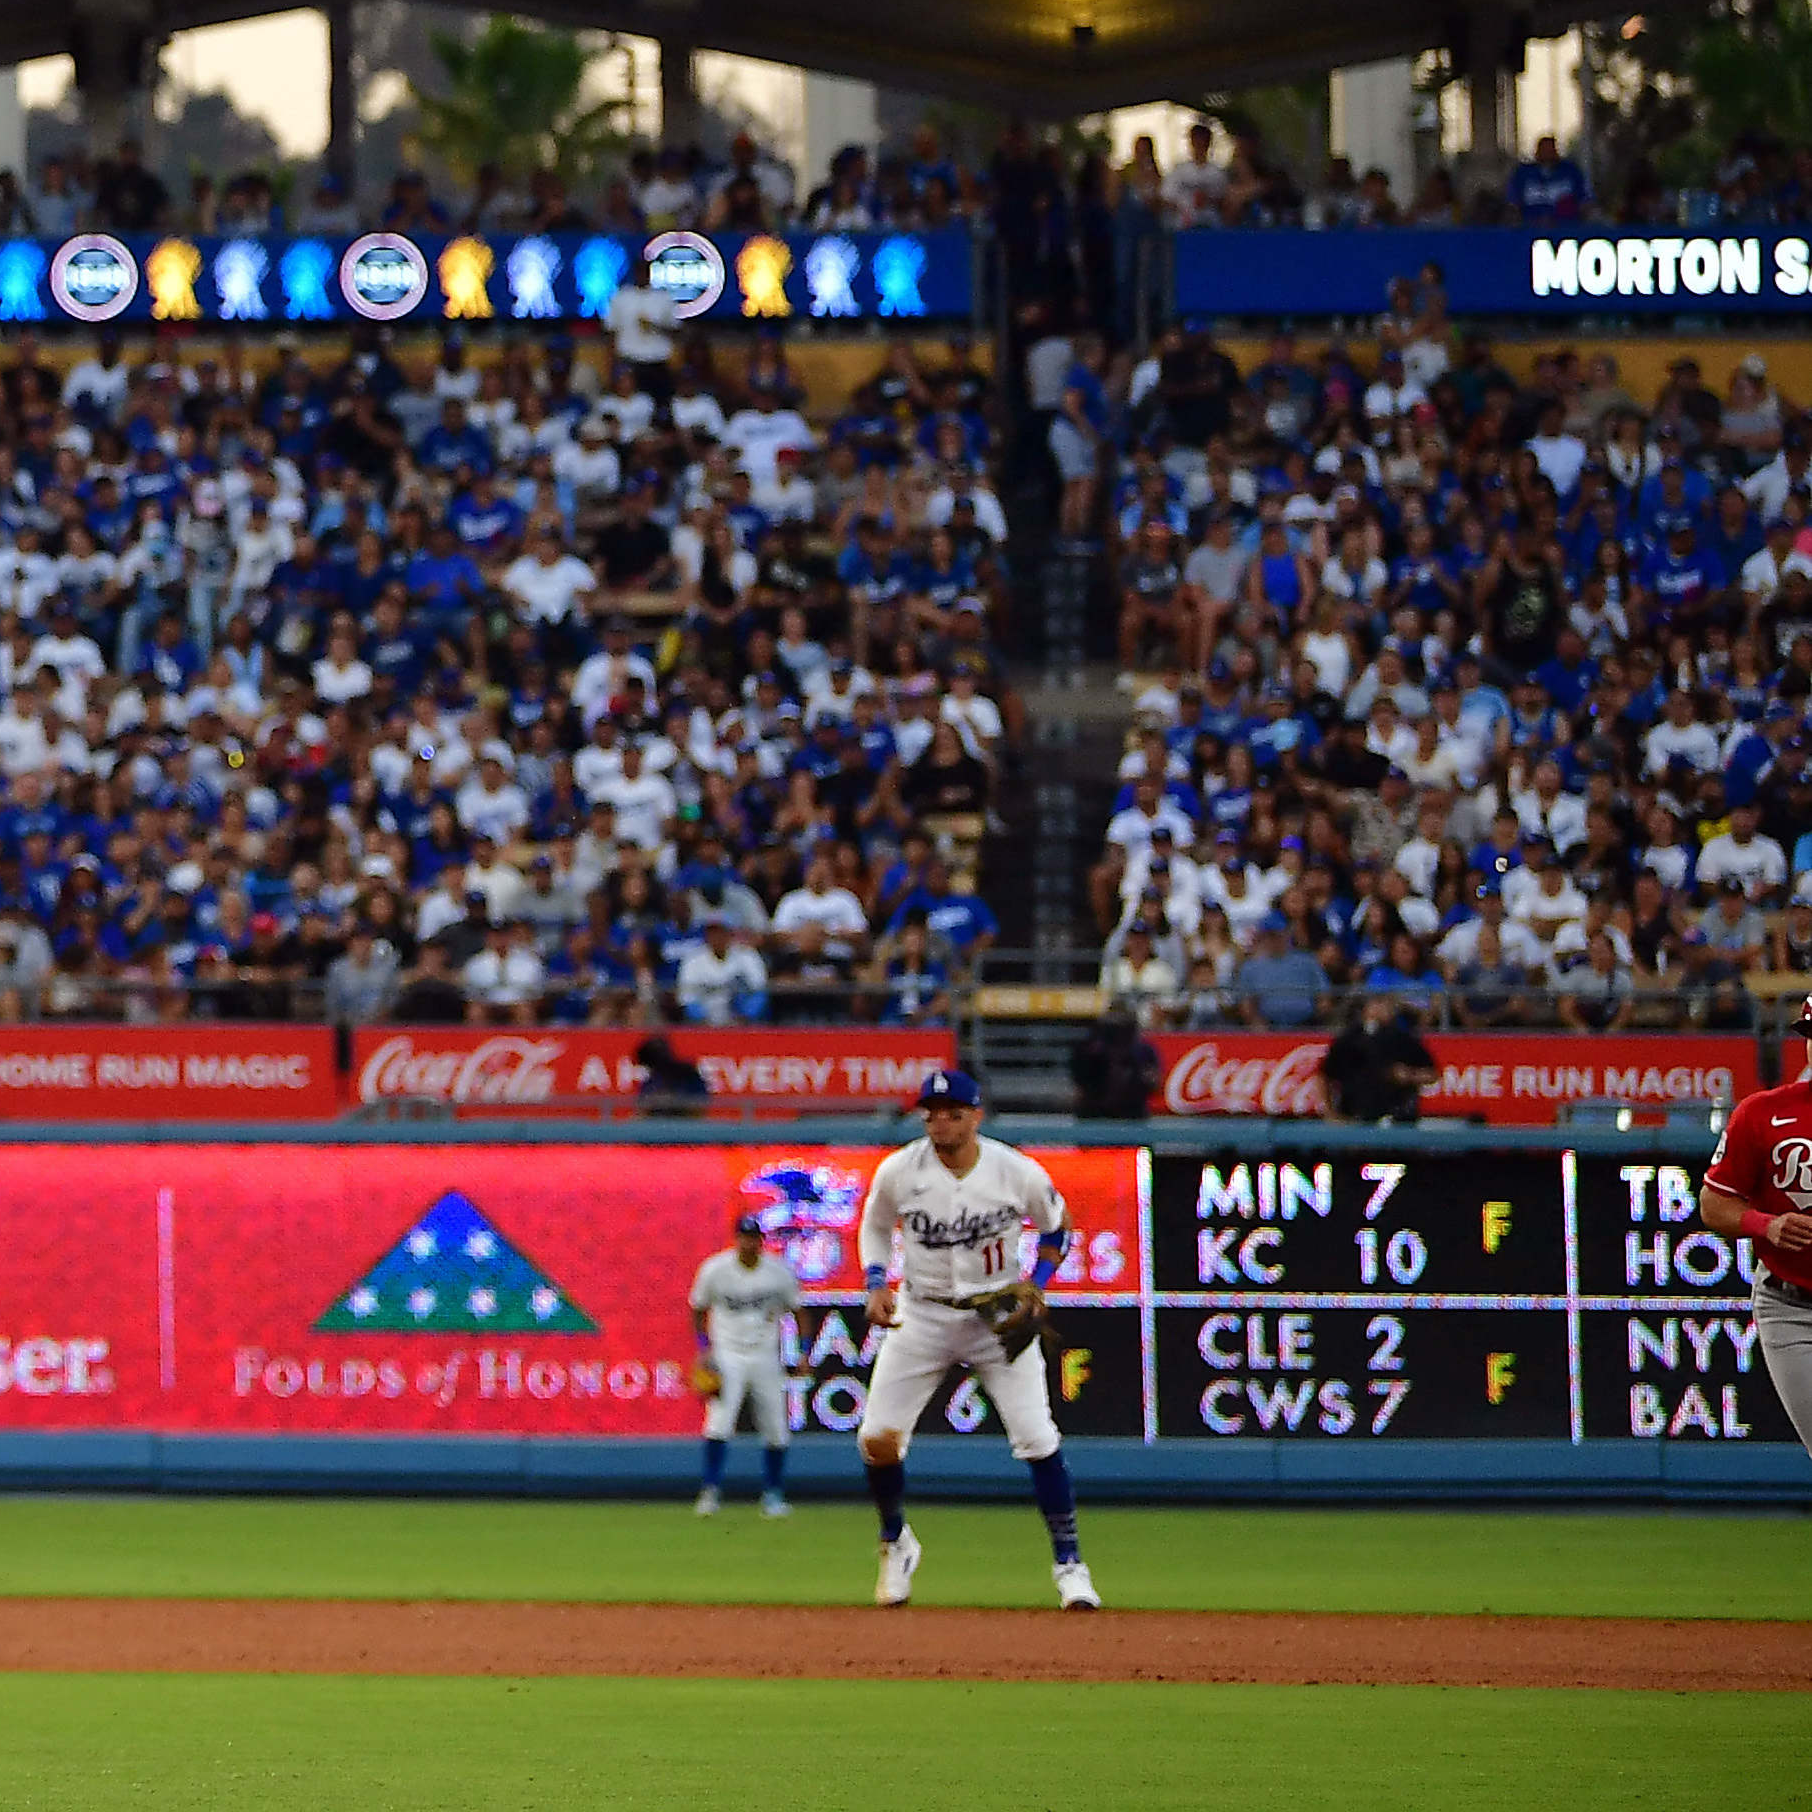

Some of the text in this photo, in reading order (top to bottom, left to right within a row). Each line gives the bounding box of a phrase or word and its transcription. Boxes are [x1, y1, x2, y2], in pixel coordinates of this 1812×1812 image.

[1530, 236, 1812, 297] MORTON S
[95, 1054, 179, 1089] RUN
[183, 1054, 310, 1089] MAGIC
[697, 1055, 833, 1093] EVERY
[1512, 1065, 1596, 1098] RUN
[1197, 1163, 1406, 1220] MIN 7
[1620, 1165, 1697, 1222] TB
[1481, 1201, 1512, 1254] F
[982, 1236, 1006, 1276] 11
[1197, 1227, 1285, 1284] KC
[1354, 1227, 1428, 1285] 10
[1197, 1313, 1407, 1371] CLE 2
[1627, 1318, 1757, 1373] NYY
[1060, 1348, 1091, 1402] F
[1486, 1352, 1516, 1405] F
[782, 1374, 987, 1433] TO 6
[1199, 1379, 1411, 1435] CWS 7
[1629, 1383, 1752, 1438] BAL
